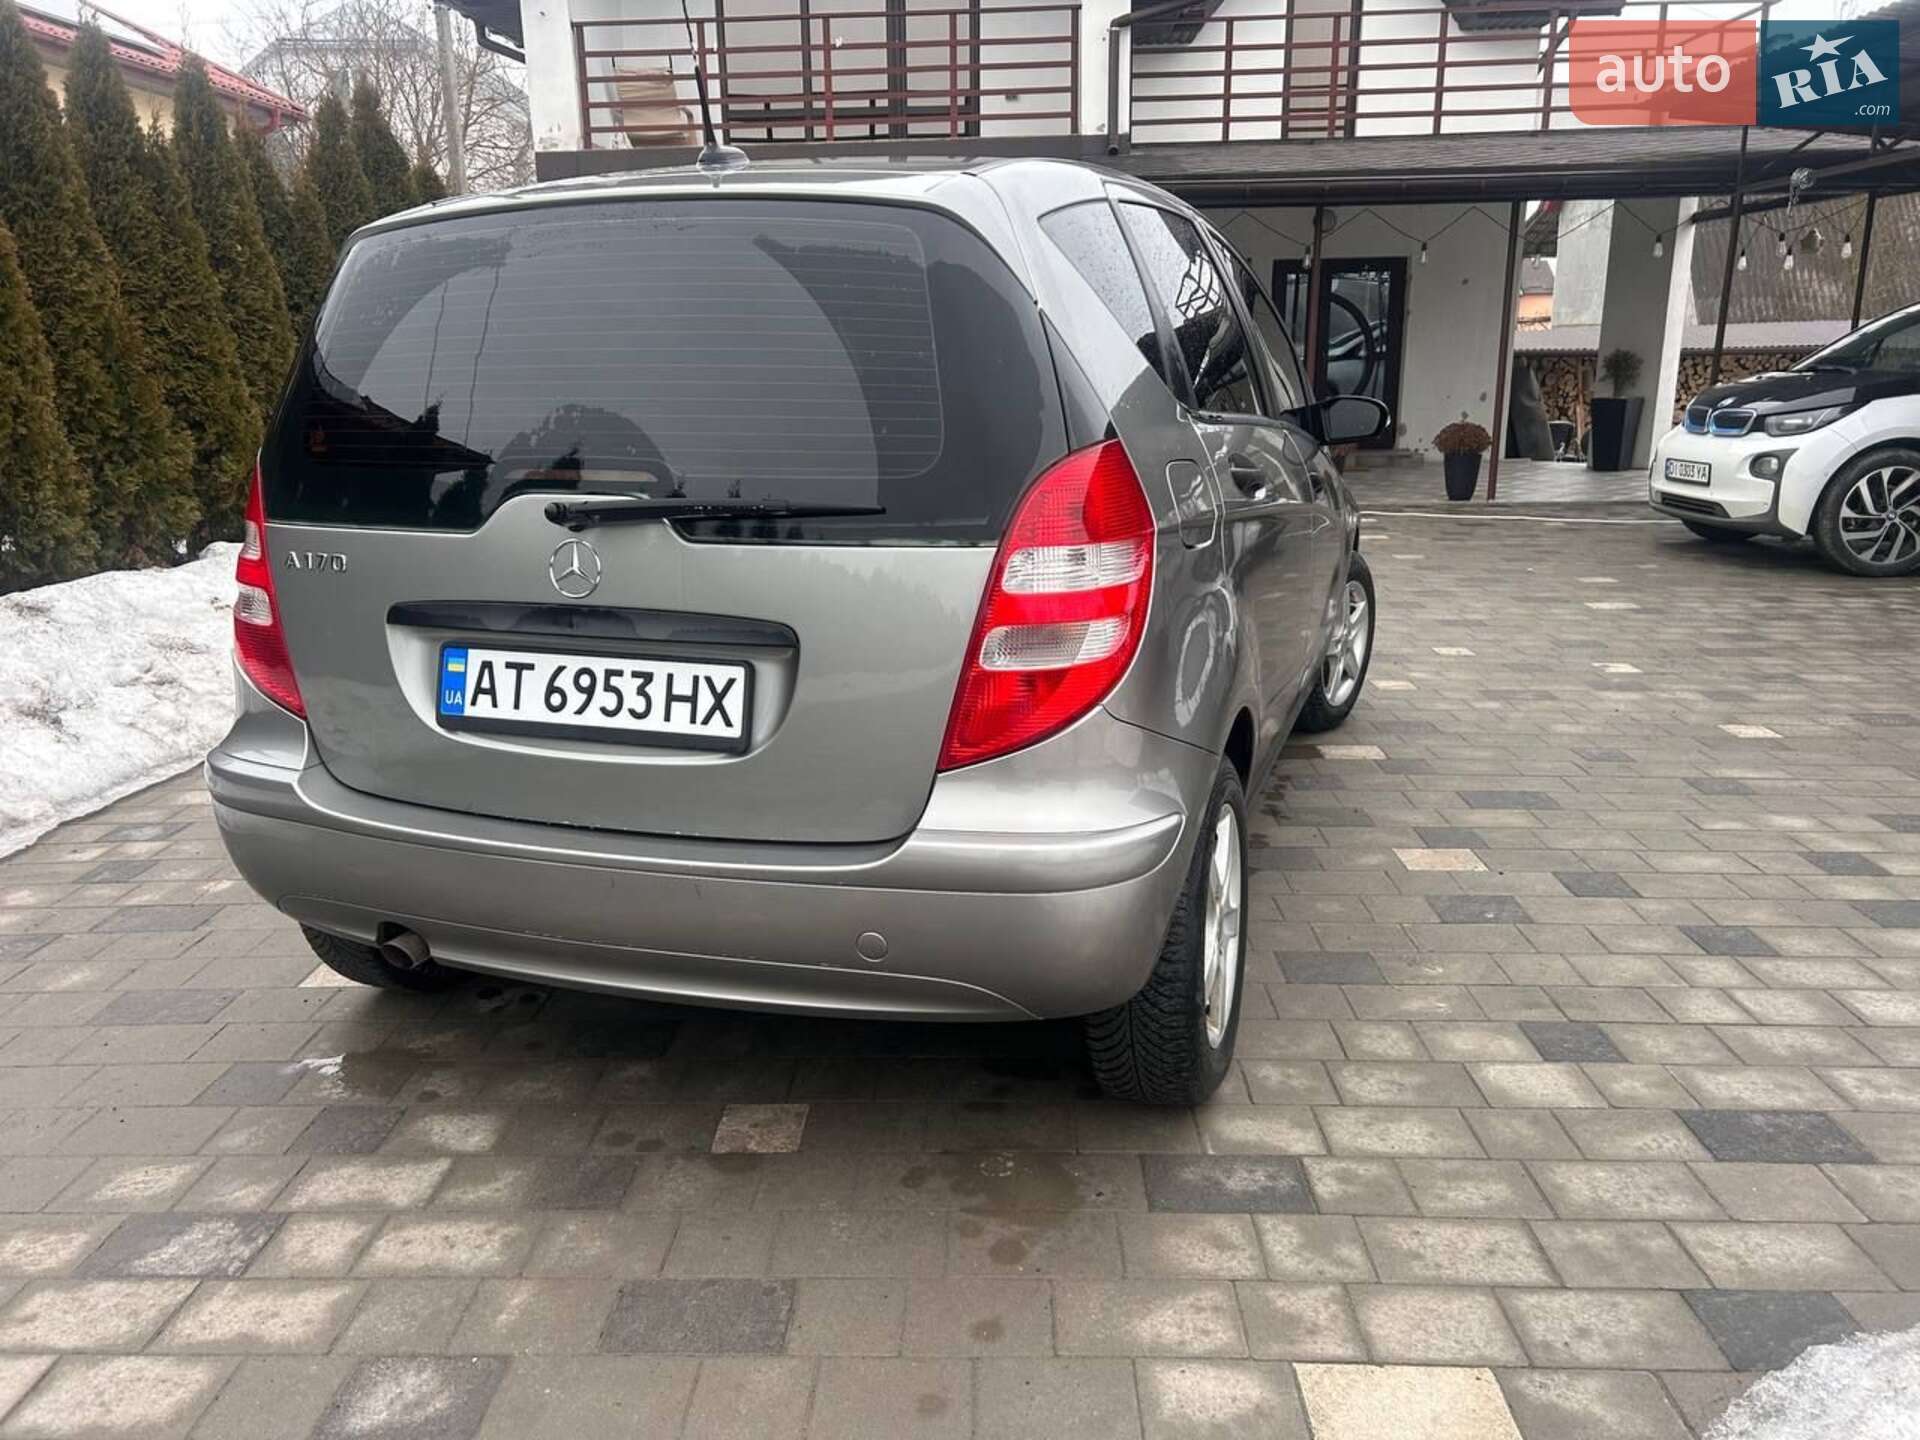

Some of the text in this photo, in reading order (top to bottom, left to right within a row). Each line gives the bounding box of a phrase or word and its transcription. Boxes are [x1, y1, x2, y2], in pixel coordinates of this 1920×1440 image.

[286, 551, 347, 572] A170
[445, 689, 463, 705] UA
[470, 660, 737, 728] AT 6953 HX
